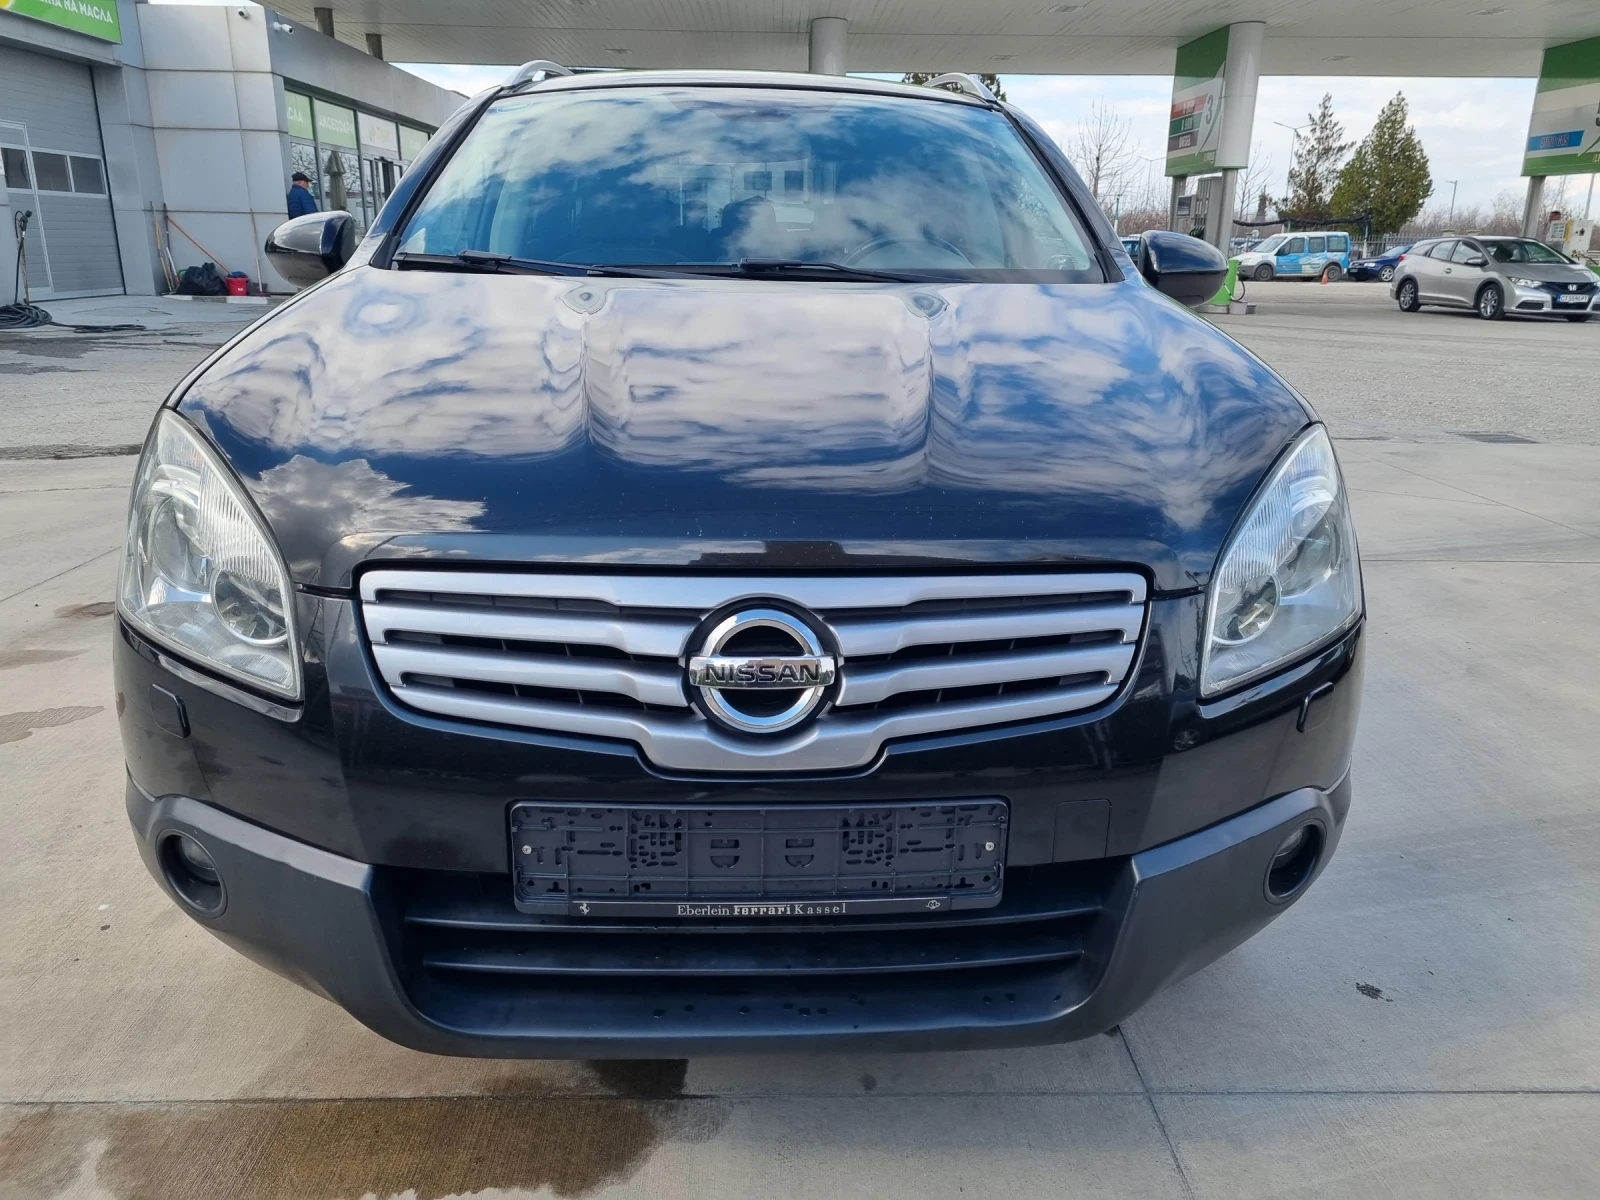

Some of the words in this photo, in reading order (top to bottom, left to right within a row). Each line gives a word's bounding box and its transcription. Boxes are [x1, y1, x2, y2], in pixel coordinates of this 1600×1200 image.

[64, 0, 79, 13] НА
[80, 2, 114, 24] МАСЛА
[286, 106, 304, 123] СЛА
[1206, 94, 1214, 125] 3
[705, 663, 820, 683] NISSAN
[676, 904, 730, 916] Eberlein
[733, 904, 791, 916] Ferrari
[793, 903, 847, 915] Kassel
